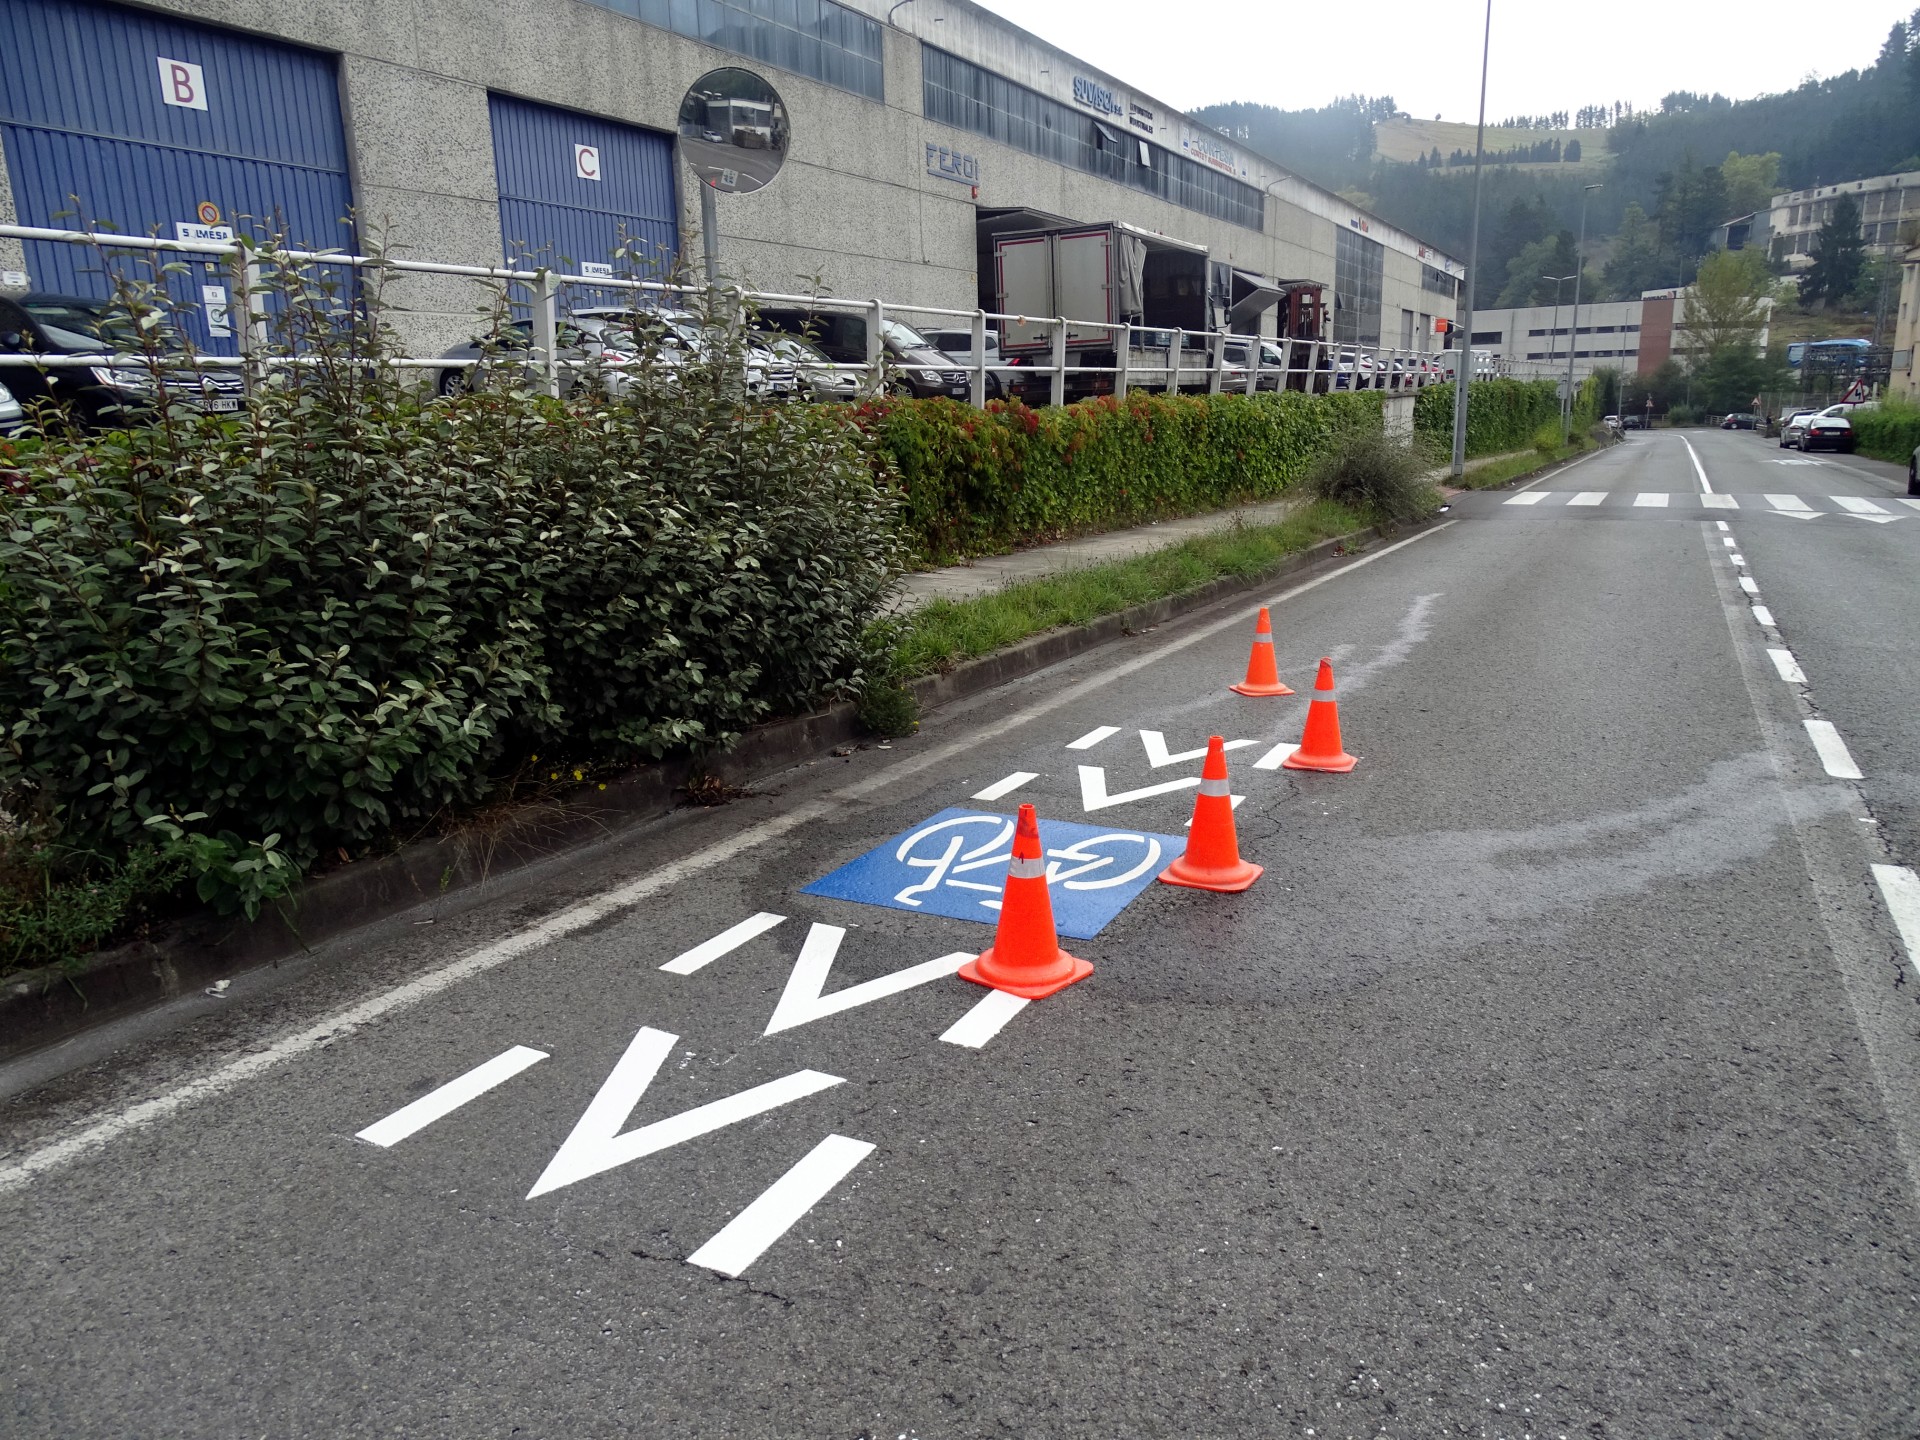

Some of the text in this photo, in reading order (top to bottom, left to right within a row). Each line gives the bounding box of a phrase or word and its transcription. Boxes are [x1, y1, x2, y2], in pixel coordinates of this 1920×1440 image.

[171, 64, 194, 103] B
[578, 148, 596, 177] C
[182, 228, 228, 240] SLMESA
